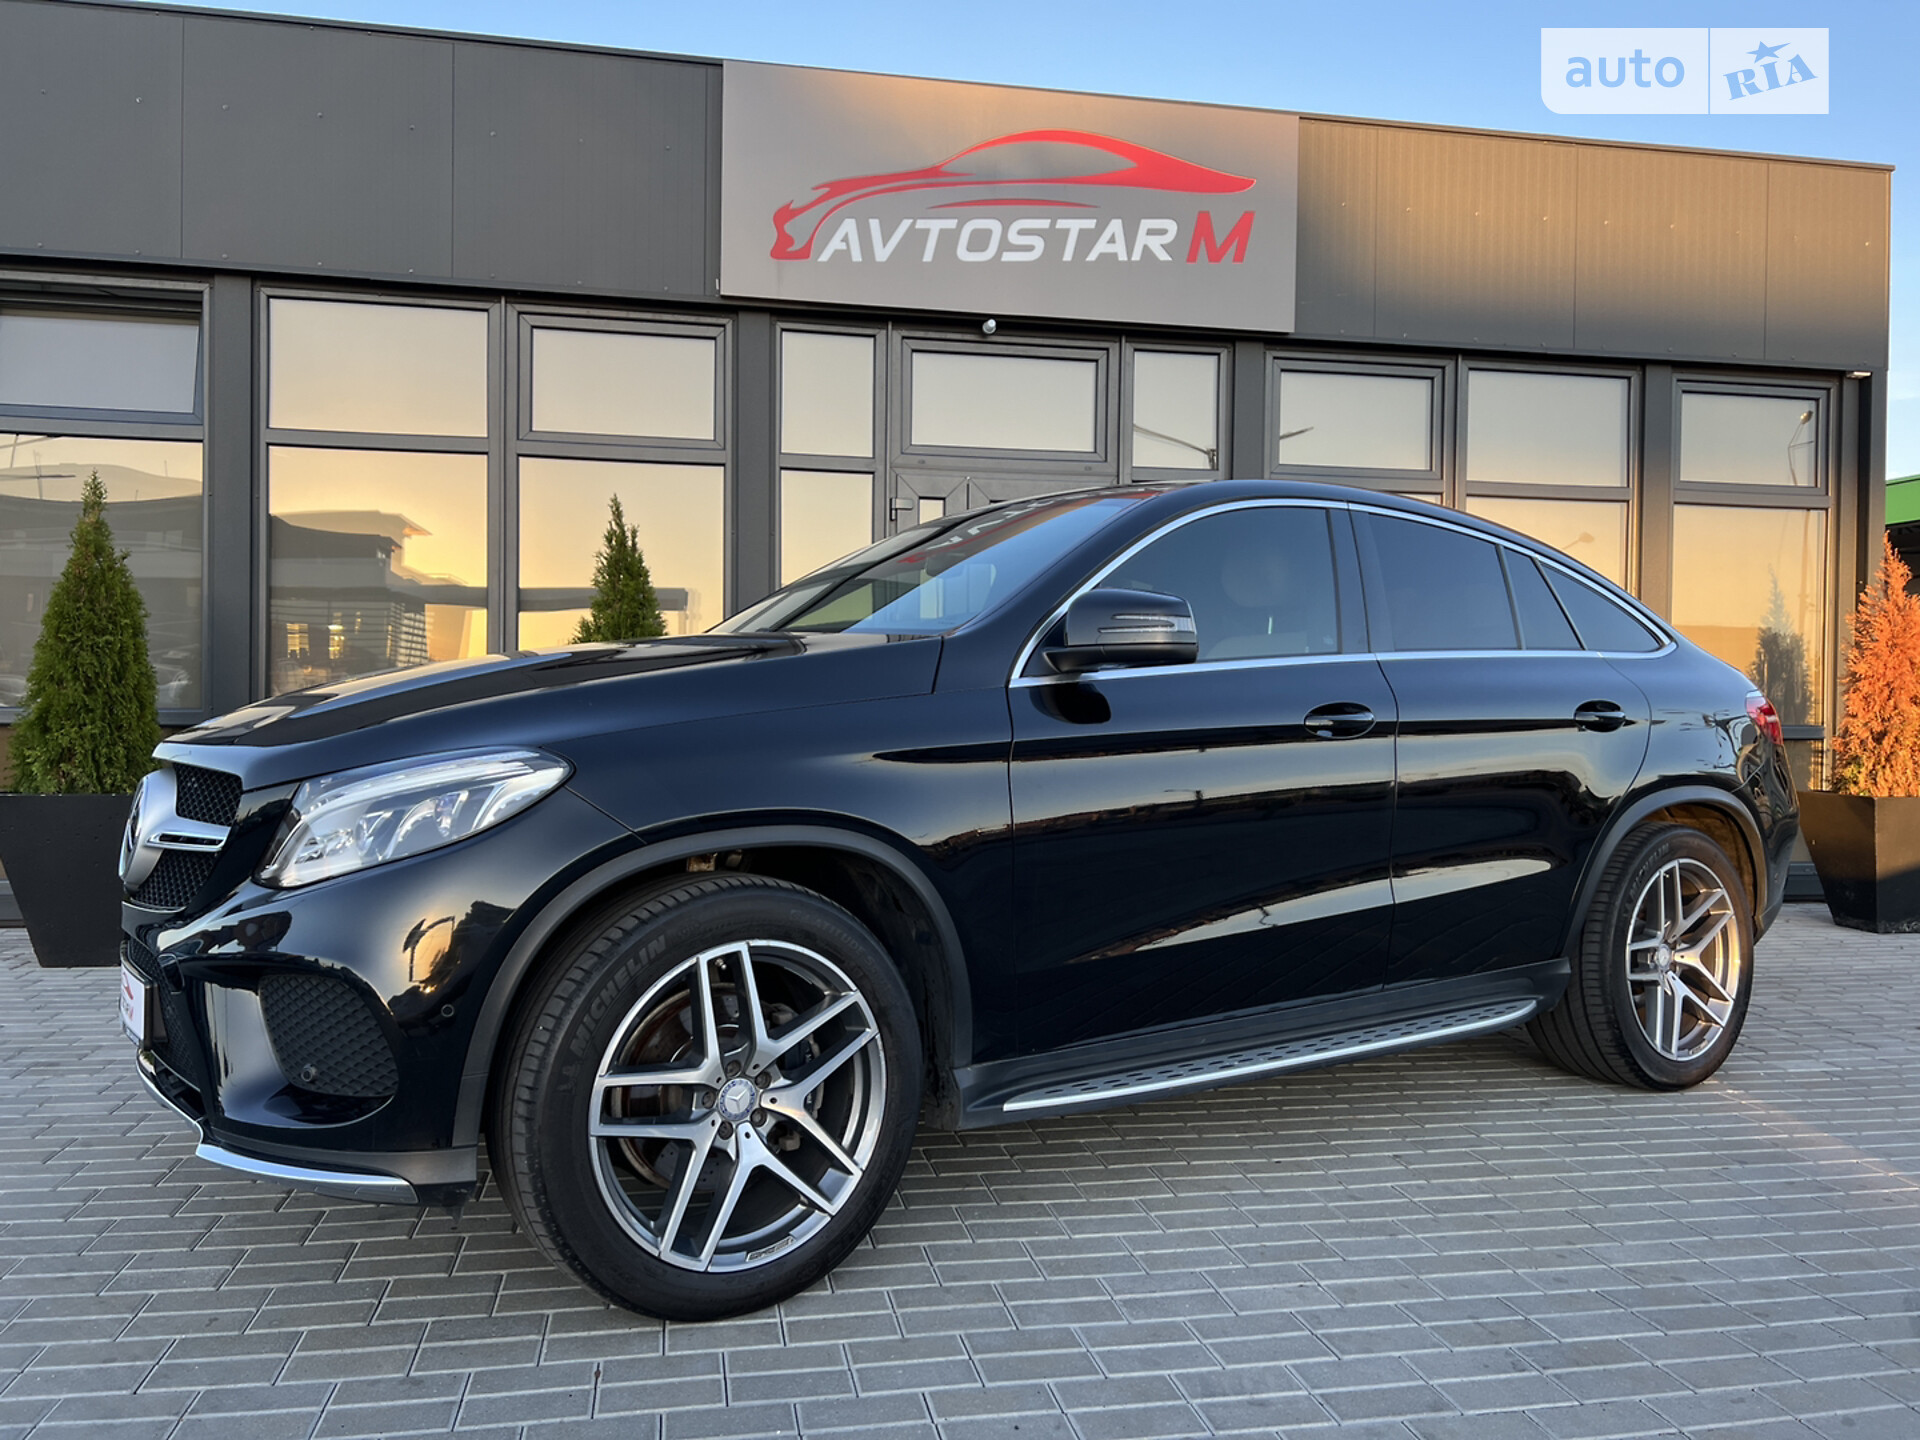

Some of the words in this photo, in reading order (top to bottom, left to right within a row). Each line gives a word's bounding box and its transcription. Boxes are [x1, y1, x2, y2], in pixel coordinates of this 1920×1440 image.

[817, 217, 1179, 263] AVTOSTAR
[1185, 210, 1255, 264] M
[569, 933, 667, 1057] MICHELIN
